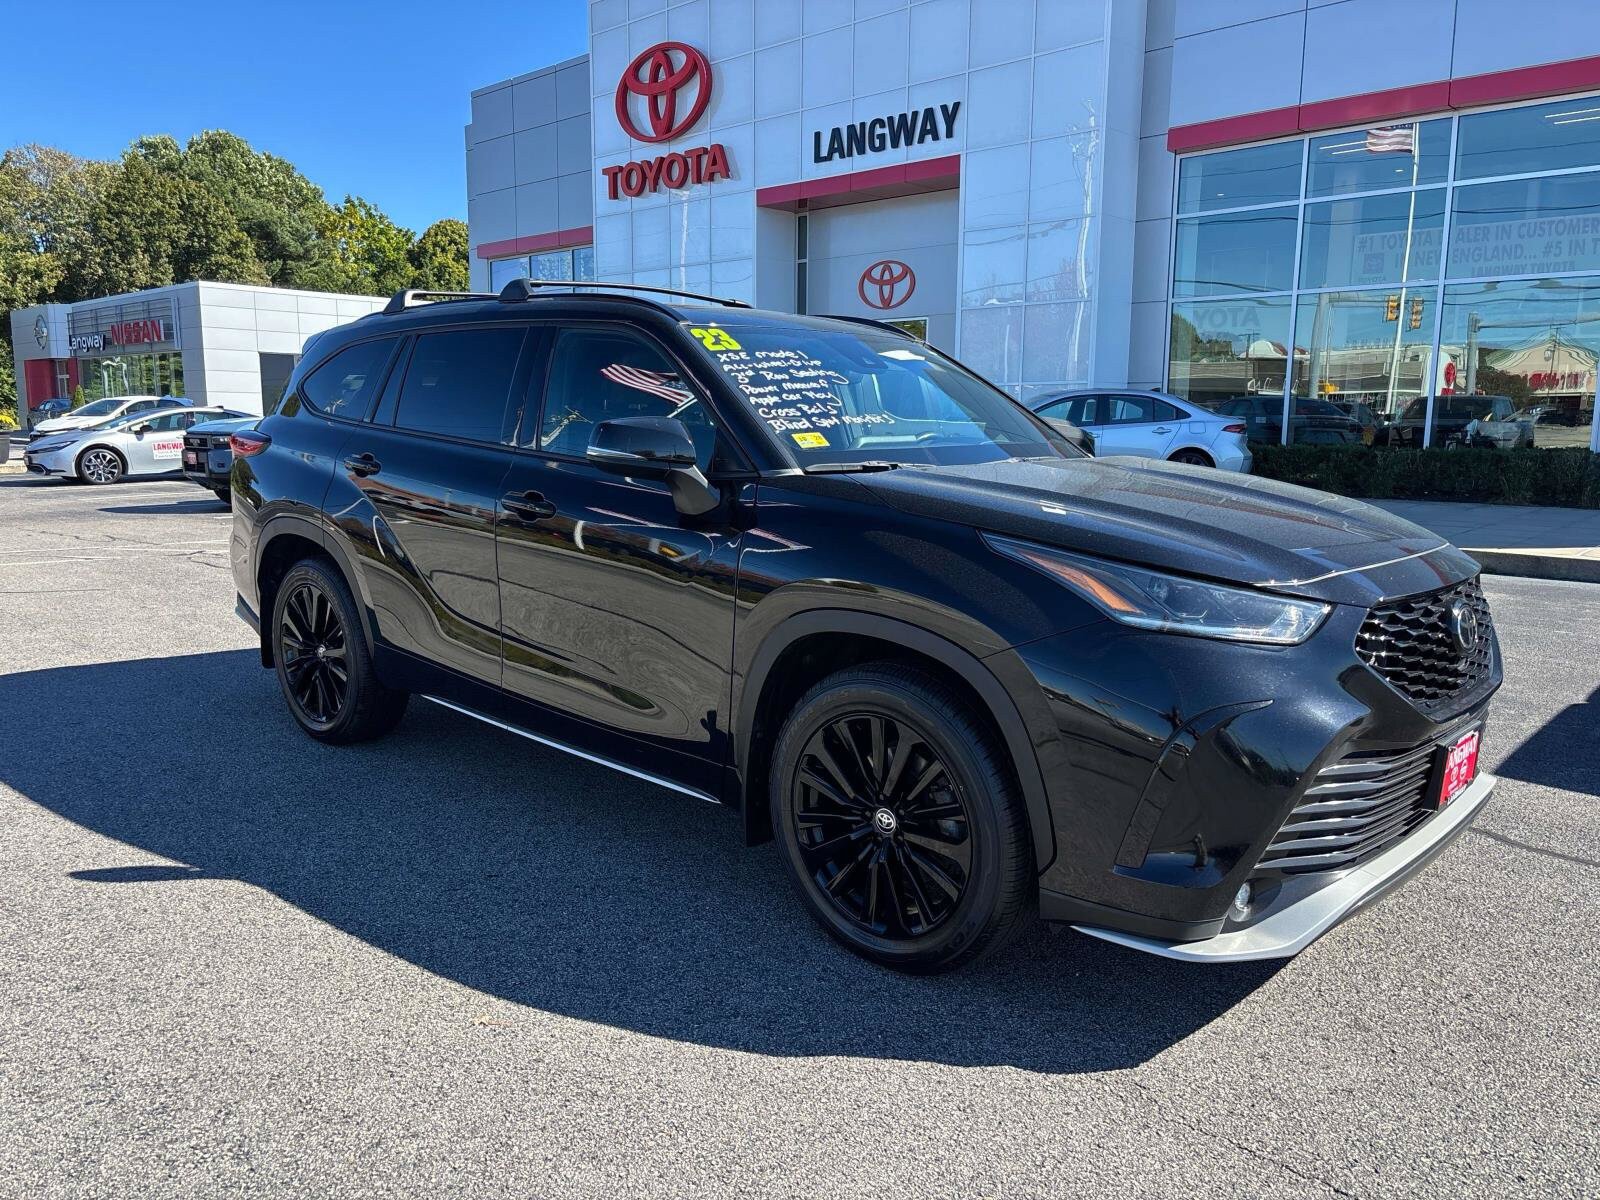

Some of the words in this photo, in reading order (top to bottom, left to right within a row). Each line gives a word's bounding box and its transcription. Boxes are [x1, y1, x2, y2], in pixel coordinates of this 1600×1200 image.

[813, 101, 961, 164] LANGWAY
[602, 143, 731, 200] TOYOTA
[1495, 224, 1512, 240] IN
[1568, 239, 1585, 256] IN
[68, 333, 104, 353] Langway
[110, 319, 165, 345] NISSAN
[690, 328, 742, 351] 23
[717, 351, 750, 362] XSE
[758, 407, 802, 418] Cross
[767, 418, 813, 434] Blind
[153, 442, 184, 451] LANGWA
